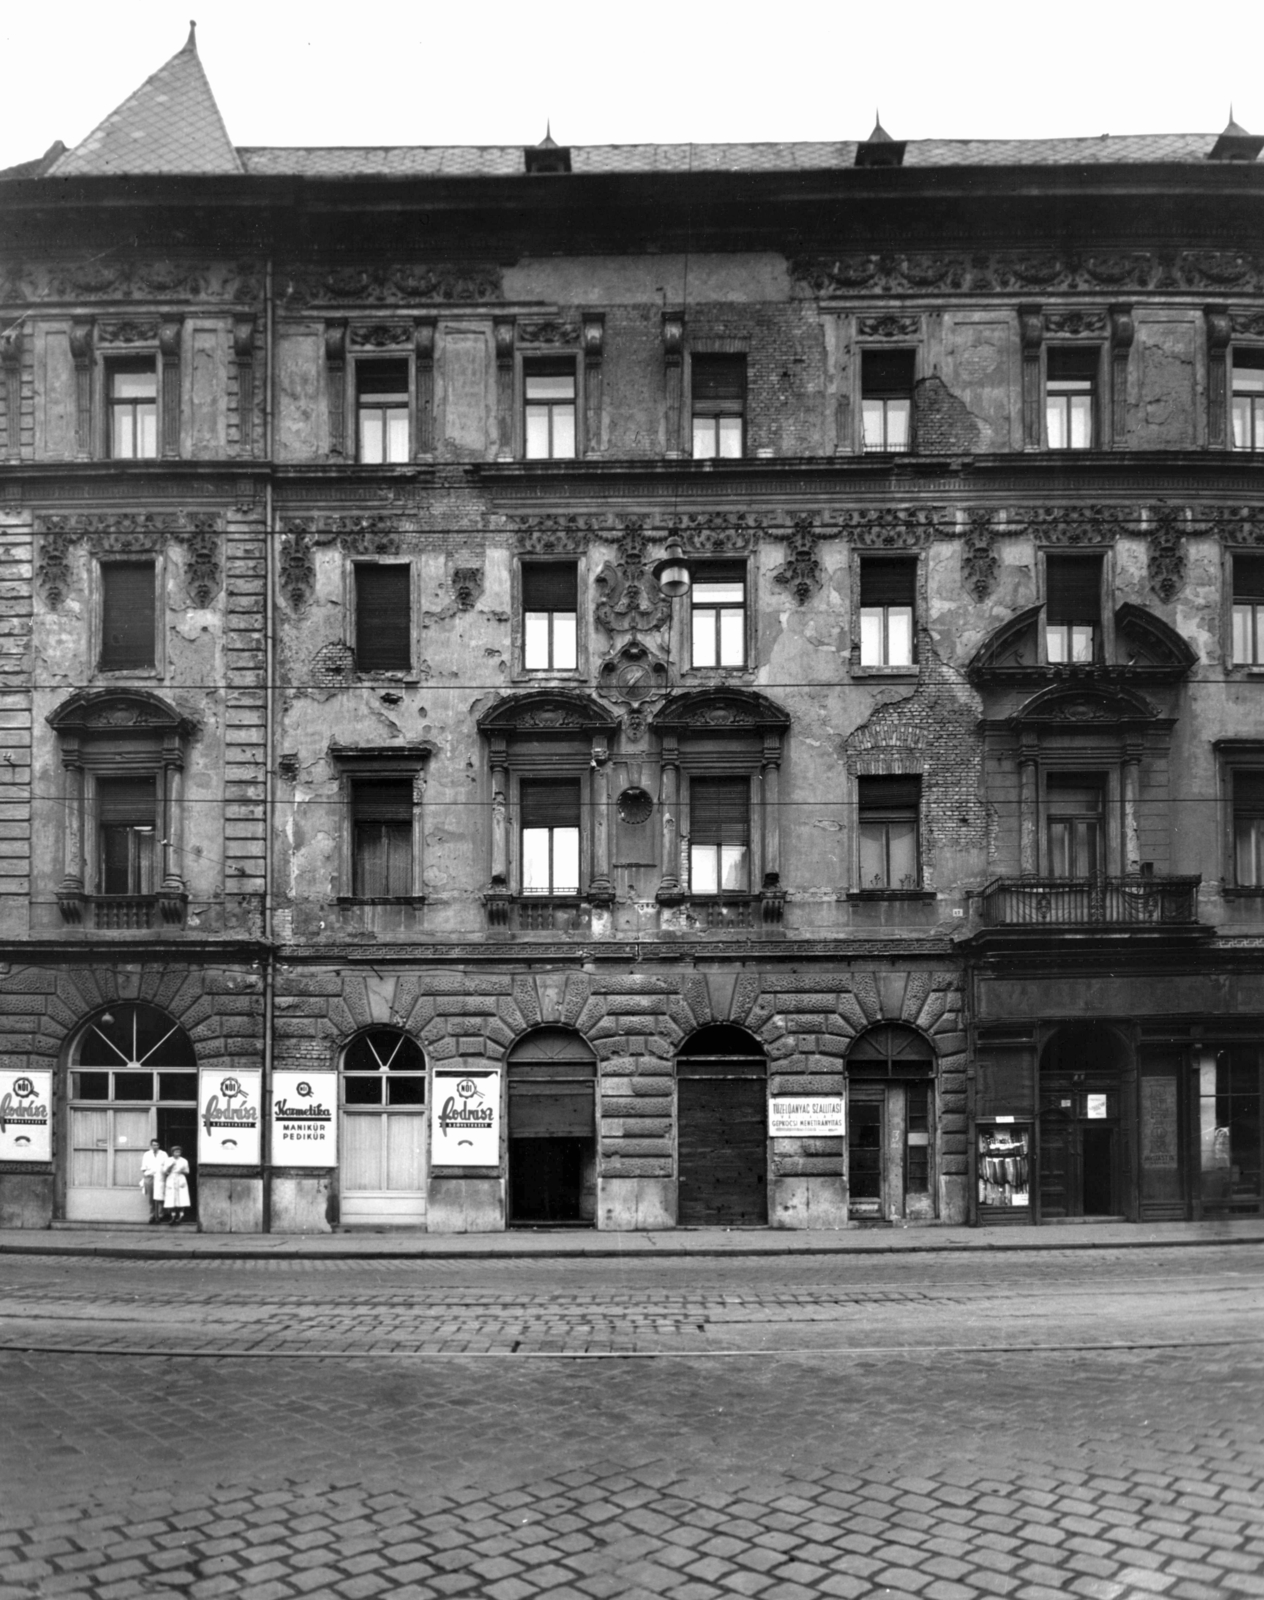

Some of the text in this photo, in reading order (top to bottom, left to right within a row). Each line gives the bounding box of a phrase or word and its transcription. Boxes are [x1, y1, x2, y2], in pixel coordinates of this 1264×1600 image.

[274, 1099, 331, 1116] Kozmetika
[438, 1096, 494, 1138] fodrász
[283, 1123, 325, 1131] MANIKÜR
[283, 1132, 325, 1140] PEDIKÜR
